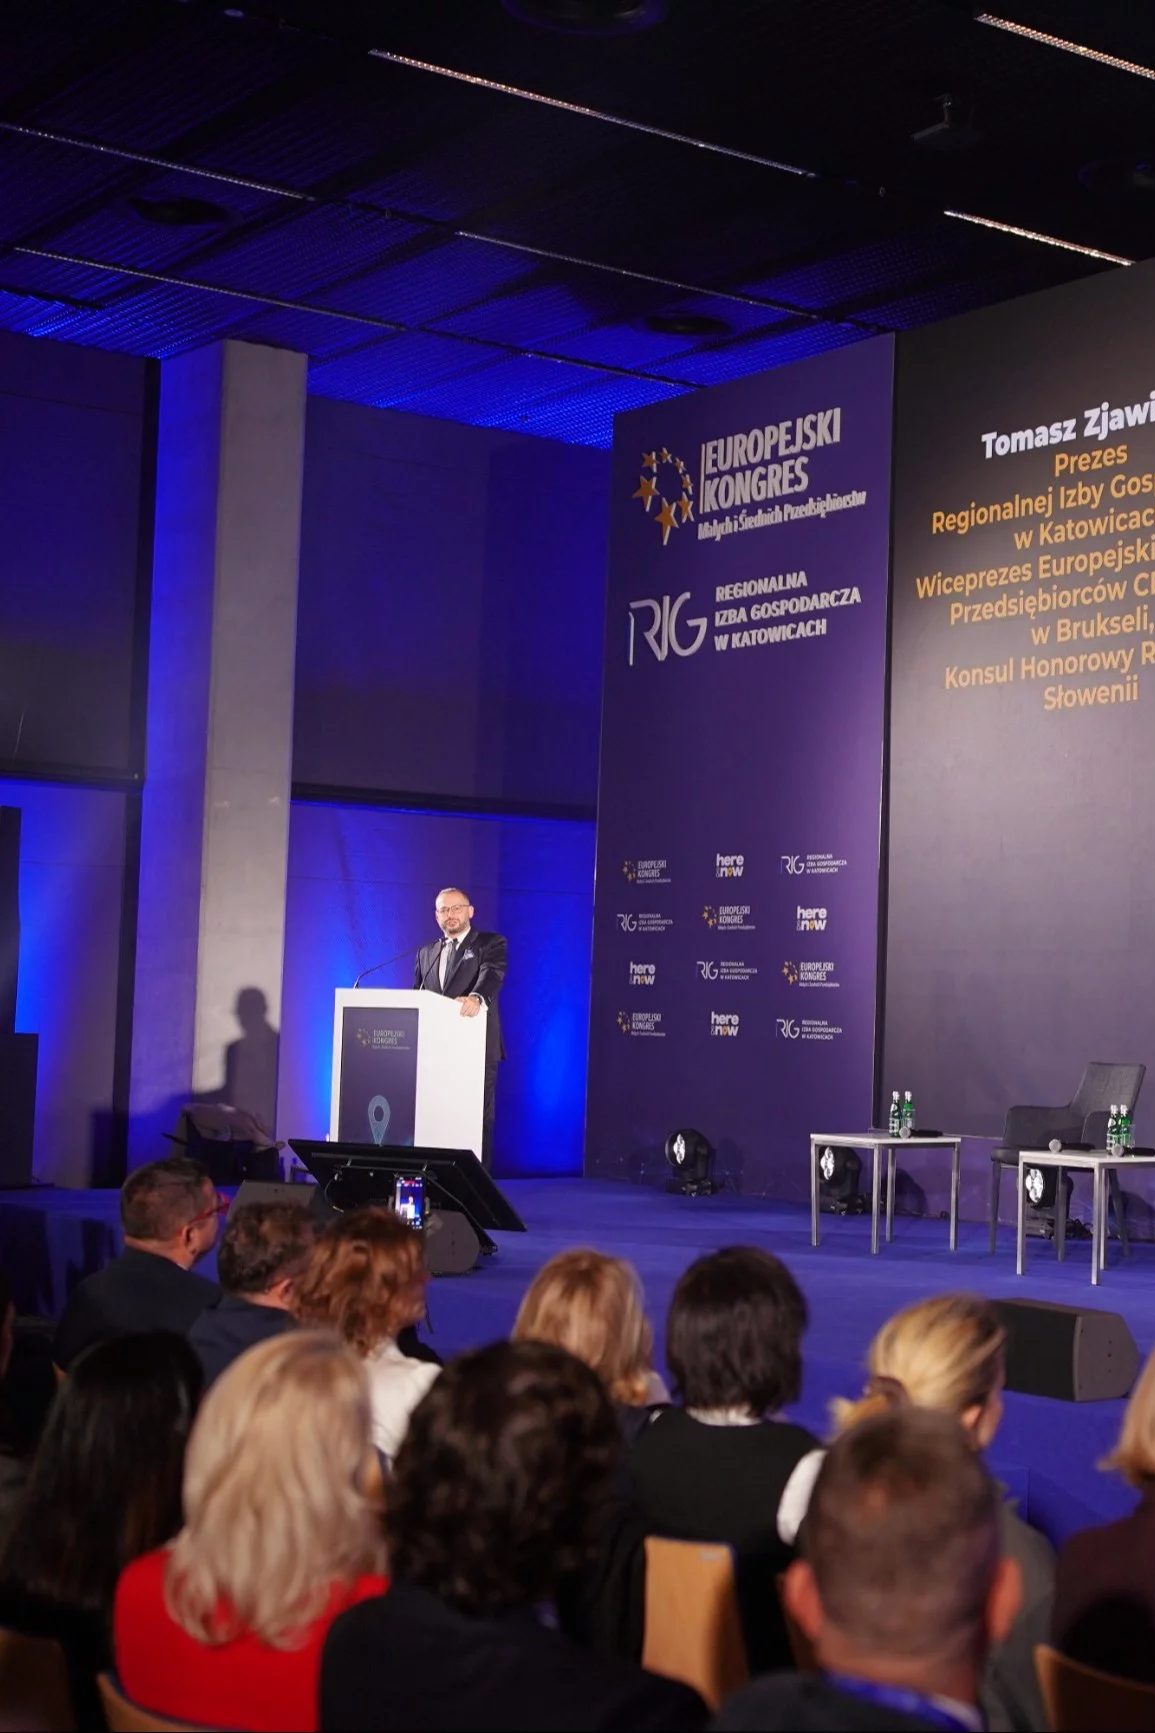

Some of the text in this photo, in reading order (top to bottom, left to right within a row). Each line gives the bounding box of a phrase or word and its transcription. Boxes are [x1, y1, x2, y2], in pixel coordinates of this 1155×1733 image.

[705, 407, 842, 474] EUROPEJSKI
[981, 419, 1077, 459] Tomasz
[1054, 444, 1128, 477] Prezes
[704, 457, 809, 513] KONGRES
[932, 487, 1054, 534] Regionalnej
[1059, 481, 1104, 510] Izby
[1014, 529, 1034, 550] w
[715, 571, 808, 602] REGIONALNA
[916, 561, 1032, 599] Wiceprezes
[714, 587, 862, 627] IZBA GOSPODARCZA
[949, 578, 1127, 626] Przedsiębiorców
[628, 592, 708, 666] RIG
[714, 618, 827, 651] W KATOWICACH
[1031, 604, 1155, 646] w Brukseli,
[945, 658, 1014, 689] Konsul
[1021, 643, 1134, 680] Honorowy
[1043, 675, 1139, 711] Słowenii
[638, 869, 660, 878] KONGRES
[716, 853, 745, 866] here
[719, 915, 744, 924] KONGRES
[796, 905, 827, 919] here
[629, 961, 656, 974] here
[800, 971, 827, 981] KONGRES
[632, 1021, 655, 1030] KONGRES
[711, 1011, 739, 1025] here
